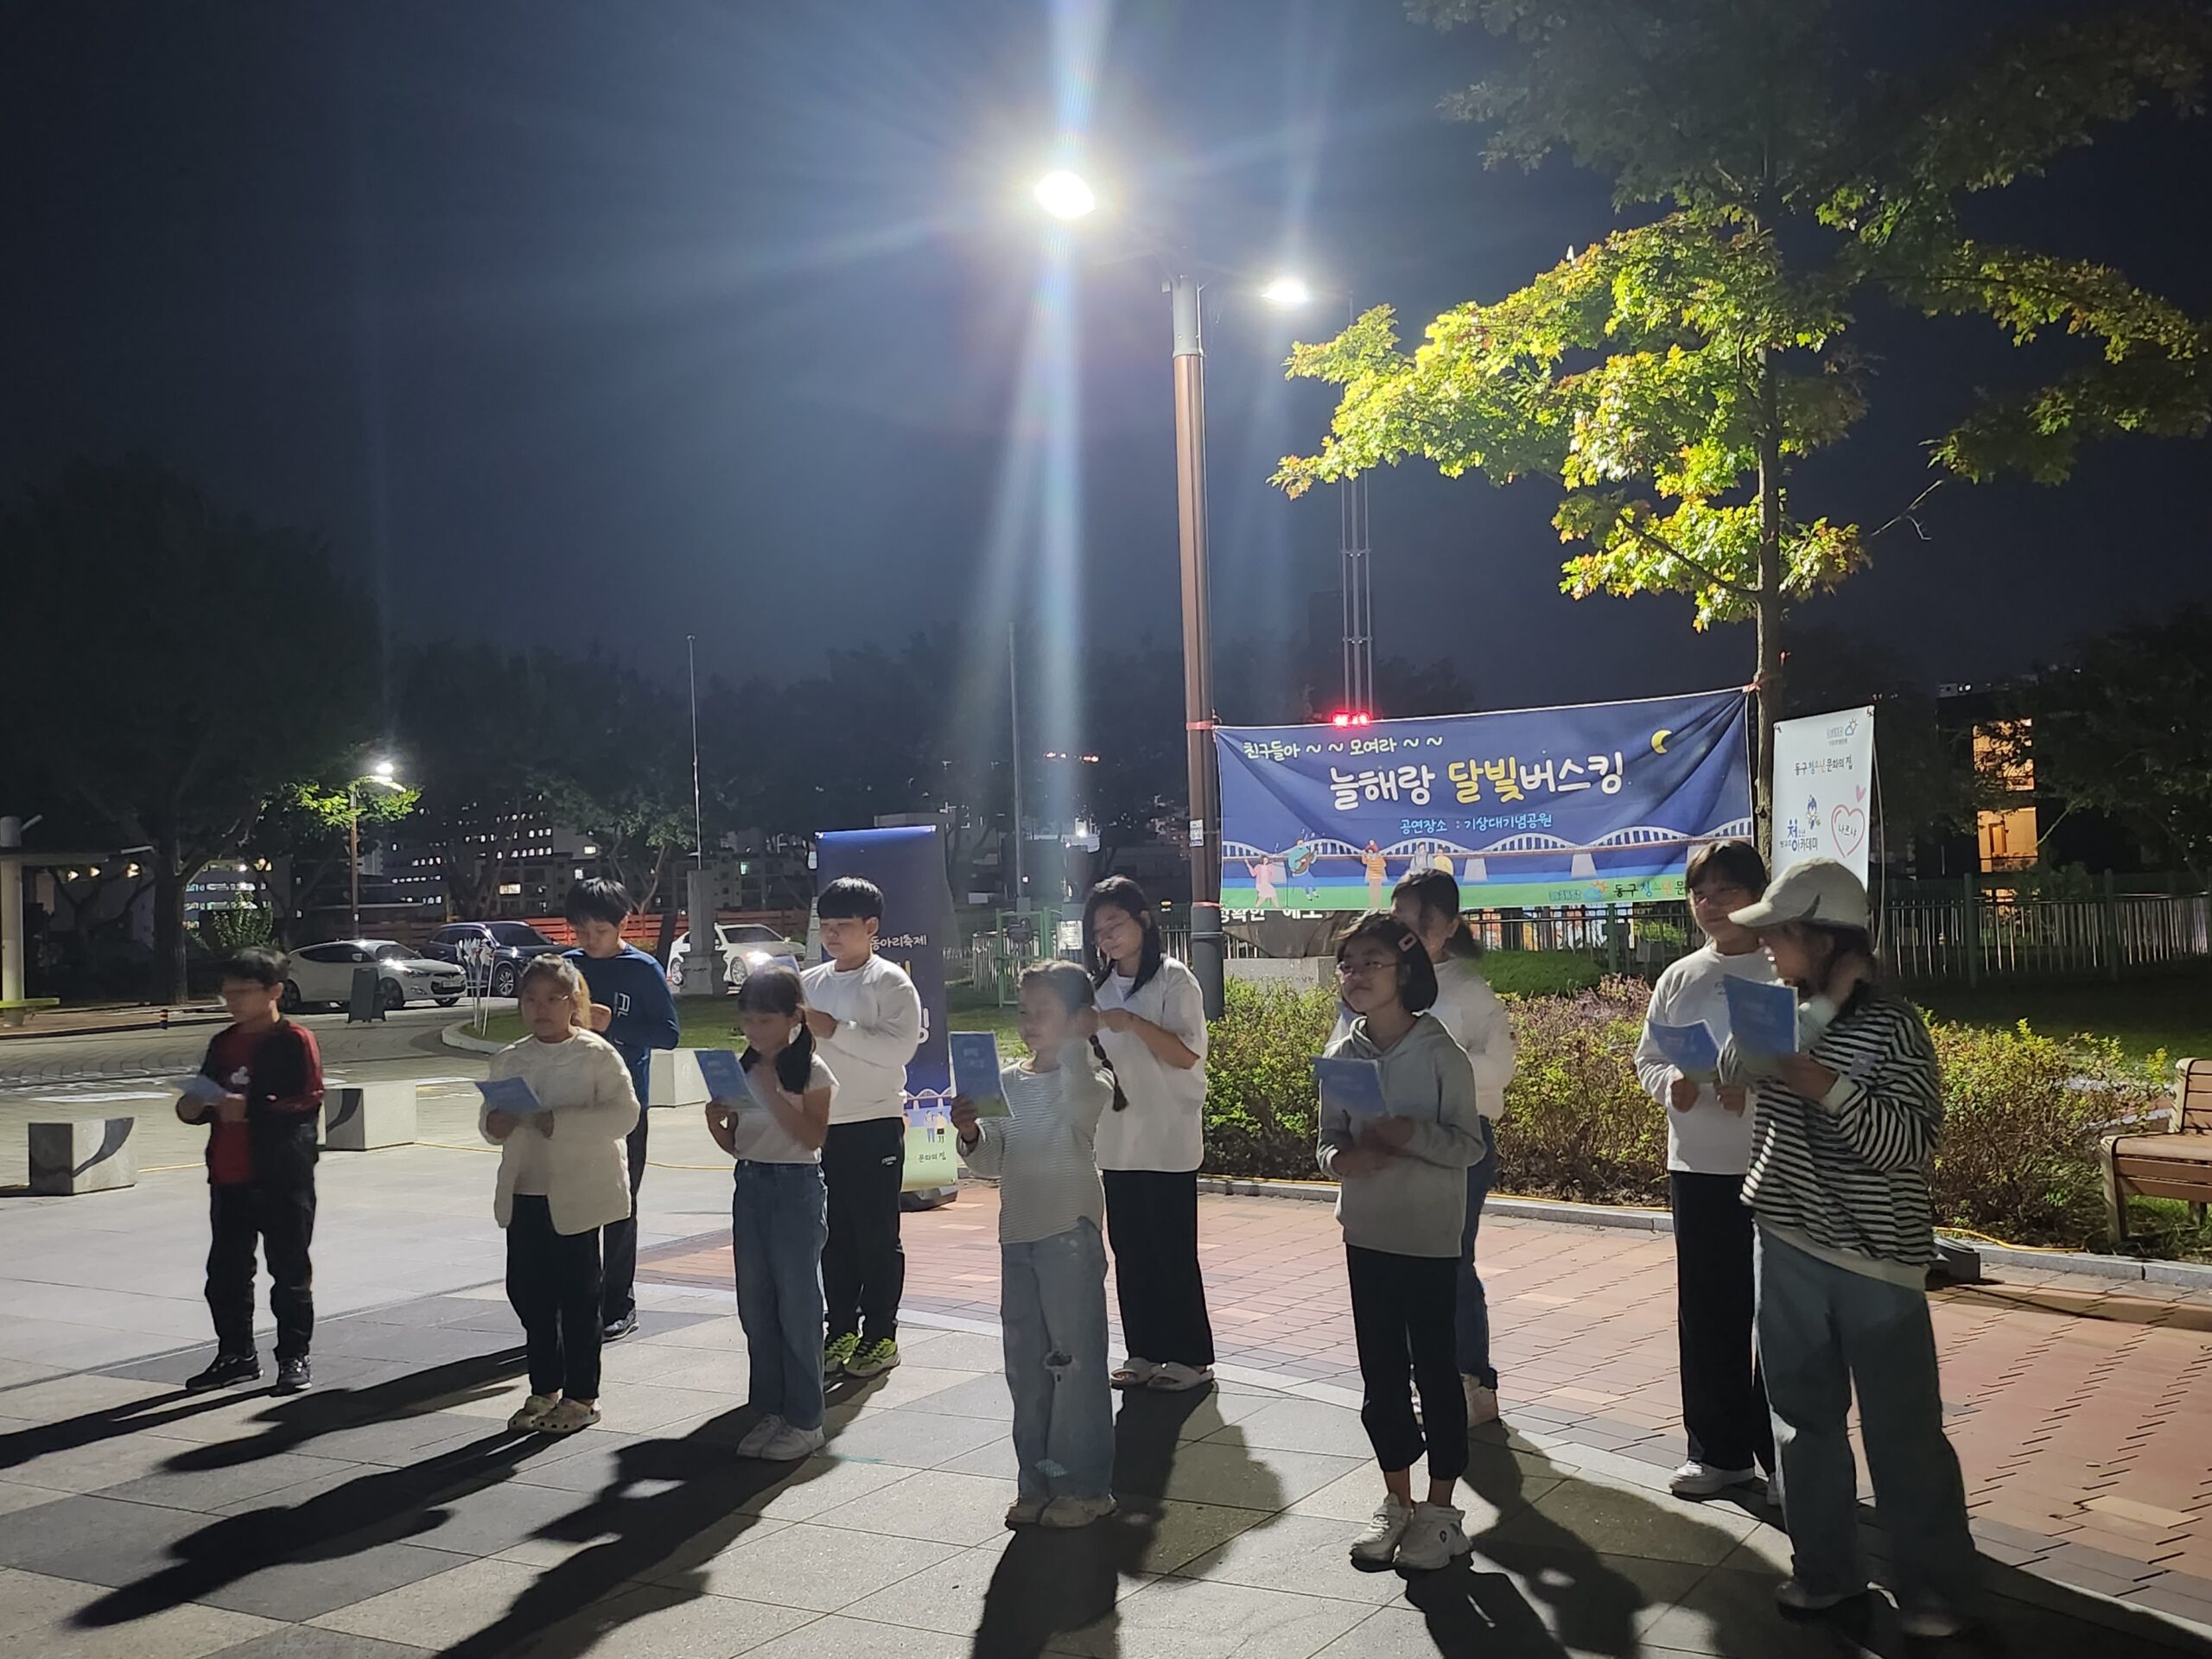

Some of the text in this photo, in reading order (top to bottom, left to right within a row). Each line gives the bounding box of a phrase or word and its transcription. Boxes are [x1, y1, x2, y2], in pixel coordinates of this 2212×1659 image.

[1243, 741, 1300, 761] 친구들아
[1350, 737, 1397, 756] 모여라
[1329, 752, 1624, 810] 늘해랑 달빛버스킹
[1400, 819, 1447, 836] 공연장소
[1464, 813, 1553, 831] 기상대기념공원
